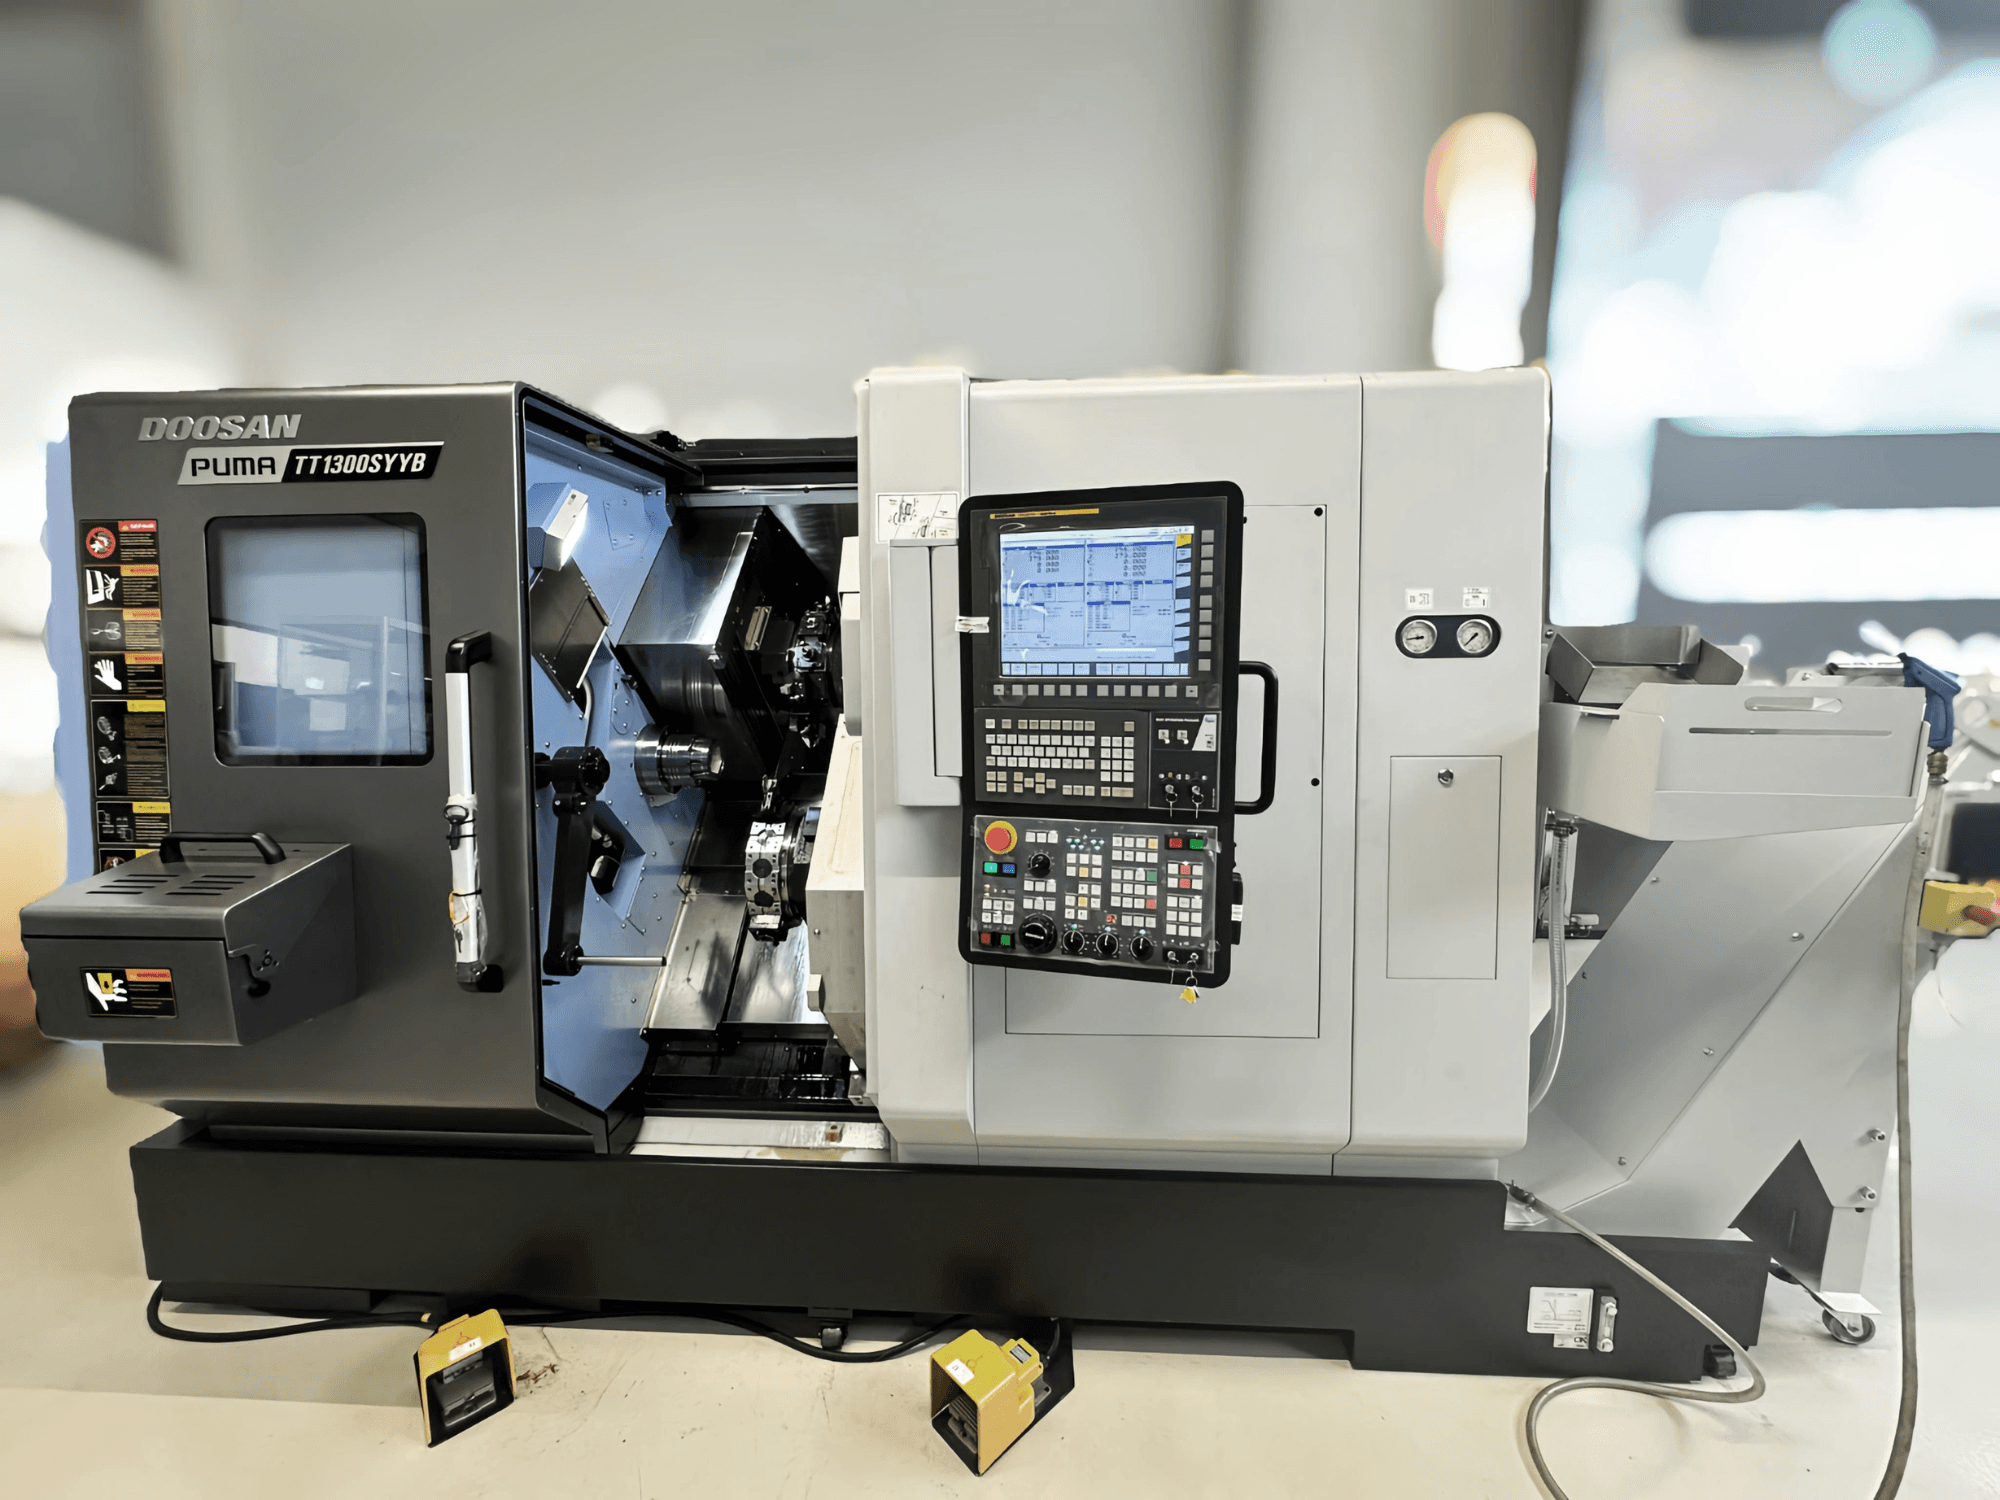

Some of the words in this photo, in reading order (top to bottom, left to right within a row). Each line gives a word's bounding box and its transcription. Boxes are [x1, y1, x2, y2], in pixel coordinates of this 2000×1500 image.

[138, 414, 301, 441] DOOSAN
[191, 457, 276, 477] PUMA
[295, 453, 427, 475] TT1300SYYB
